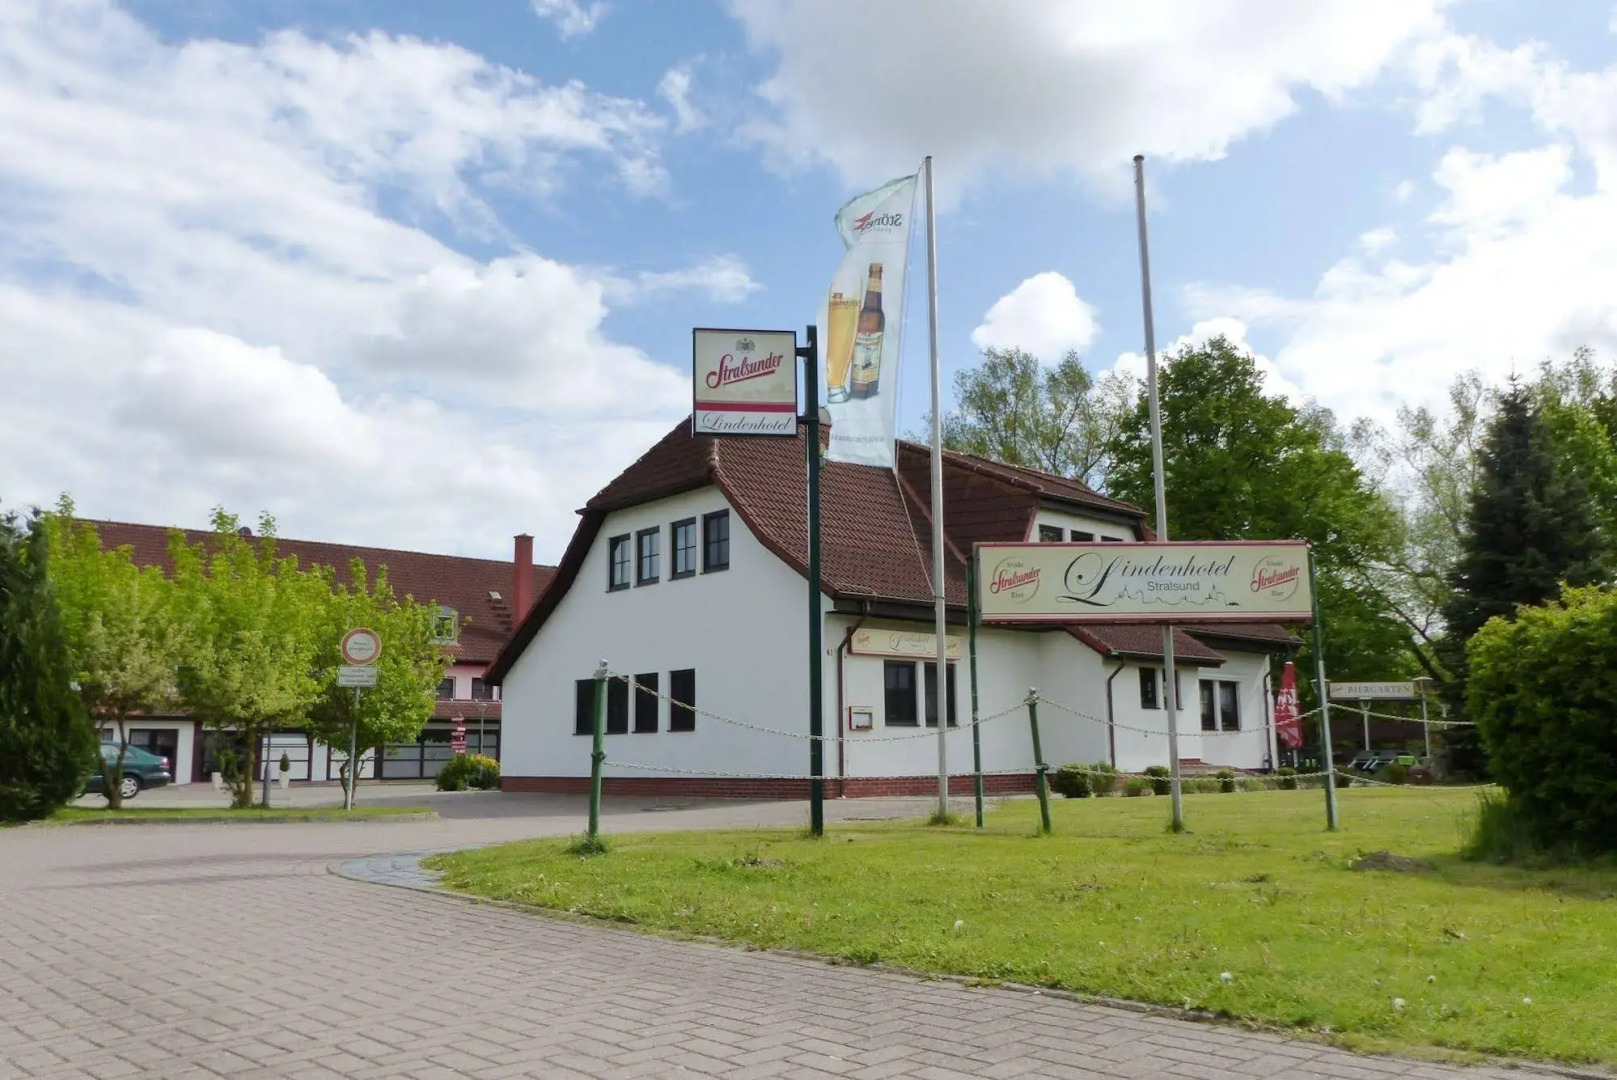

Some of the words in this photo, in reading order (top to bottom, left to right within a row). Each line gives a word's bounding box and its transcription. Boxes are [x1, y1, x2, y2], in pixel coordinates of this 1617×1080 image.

[706, 352, 784, 389] Stralsunder
[702, 412, 792, 431] Lindenhotel
[990, 567, 1041, 594] Stralsunder
[1055, 552, 1236, 607] Lindenhotel
[1146, 580, 1200, 592] Stralsund
[1250, 566, 1300, 593] Stralsunder
[1347, 685, 1410, 694] BIERGARTEN
